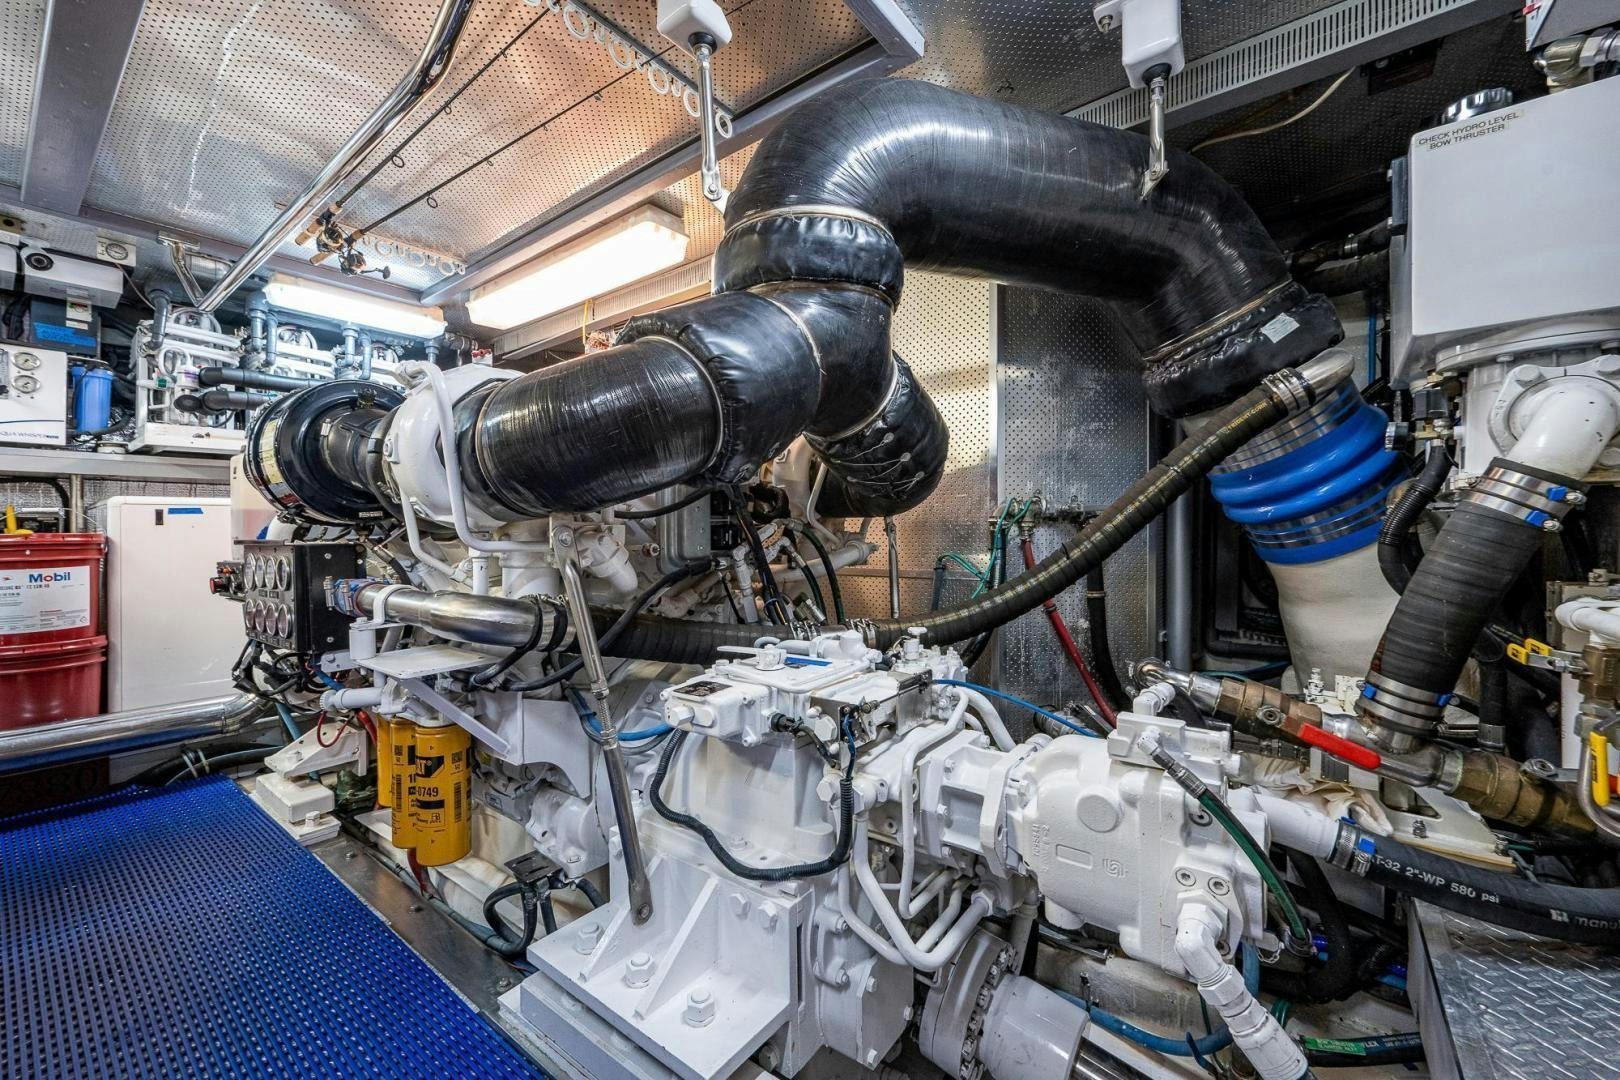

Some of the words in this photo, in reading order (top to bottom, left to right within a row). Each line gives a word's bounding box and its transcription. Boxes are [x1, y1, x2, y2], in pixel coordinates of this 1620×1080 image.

[1418, 131, 1450, 145] CHECK
[1452, 121, 1486, 136] HYDRO
[1488, 112, 1519, 126] LEVEL
[1429, 139, 1452, 150] BOW
[1454, 123, 1505, 143] THRUSTER
[28, 571, 71, 583] Mobil
[1371, 854, 1401, 872] T-32
[1450, 882, 1476, 898] 580
[1481, 892, 1500, 904] psi
[1575, 915, 1620, 930] manu
